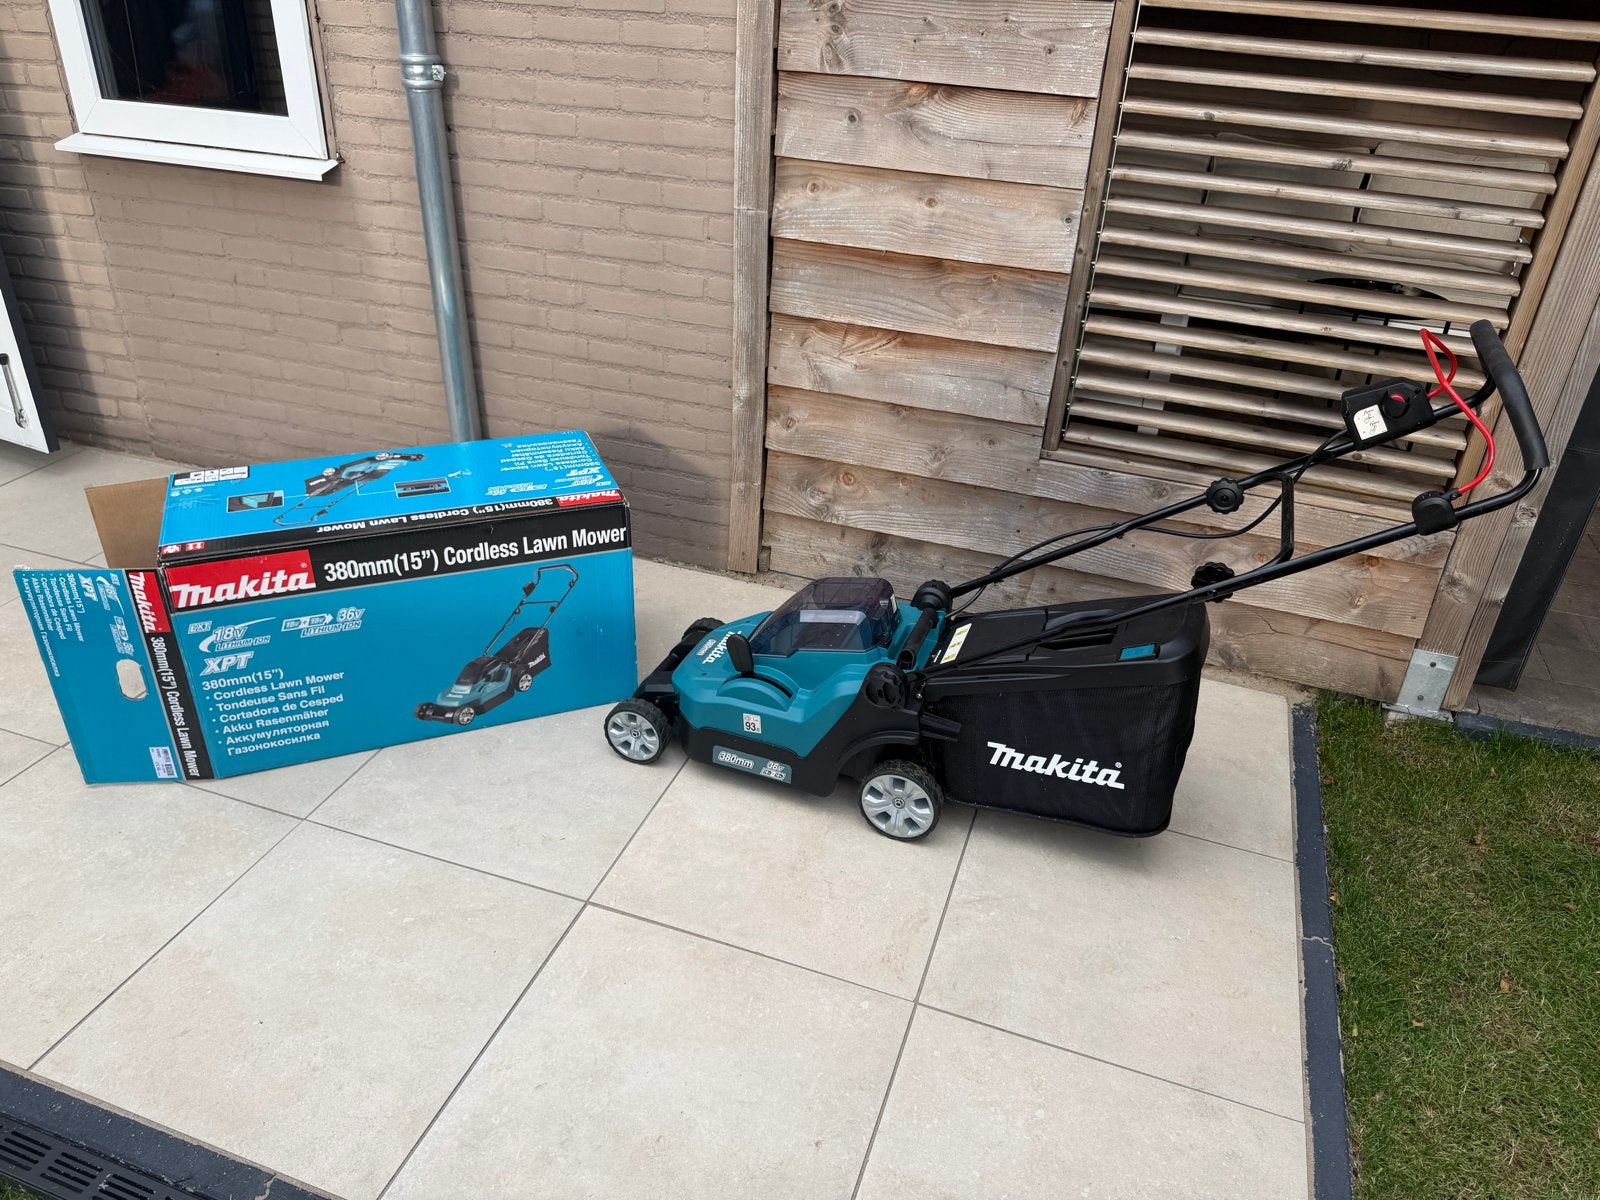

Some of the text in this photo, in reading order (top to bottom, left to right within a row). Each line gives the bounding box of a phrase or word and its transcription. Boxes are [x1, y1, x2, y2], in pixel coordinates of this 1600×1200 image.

[316, 521, 366, 534] Mower
[369, 516, 408, 527] Lawn
[410, 507, 470, 521] Cordless
[443, 541, 519, 566] Cordless
[523, 534, 568, 555] Lawn
[572, 526, 627, 548] Mower
[50, 576, 63, 607] Tondeuse
[59, 577, 72, 605] Cordless
[78, 573, 98, 602] XPT
[200, 651, 254, 676] XPT
[213, 671, 345, 701] Cordless Lawn Mower
[216, 685, 326, 712] Tondeuse Sans Fil
[166, 690, 186, 727] Cordless
[219, 693, 344, 723] Cortadora de Cesped
[222, 708, 329, 735] Akku Rasenmäher
[177, 727, 192, 749] Lawn
[225, 719, 330, 745] Аккумуляторная
[745, 721, 756, 732] 93
[227, 732, 321, 756] Газонокосилка
[184, 749, 200, 777] Mower
[718, 750, 754, 769] 380mm
